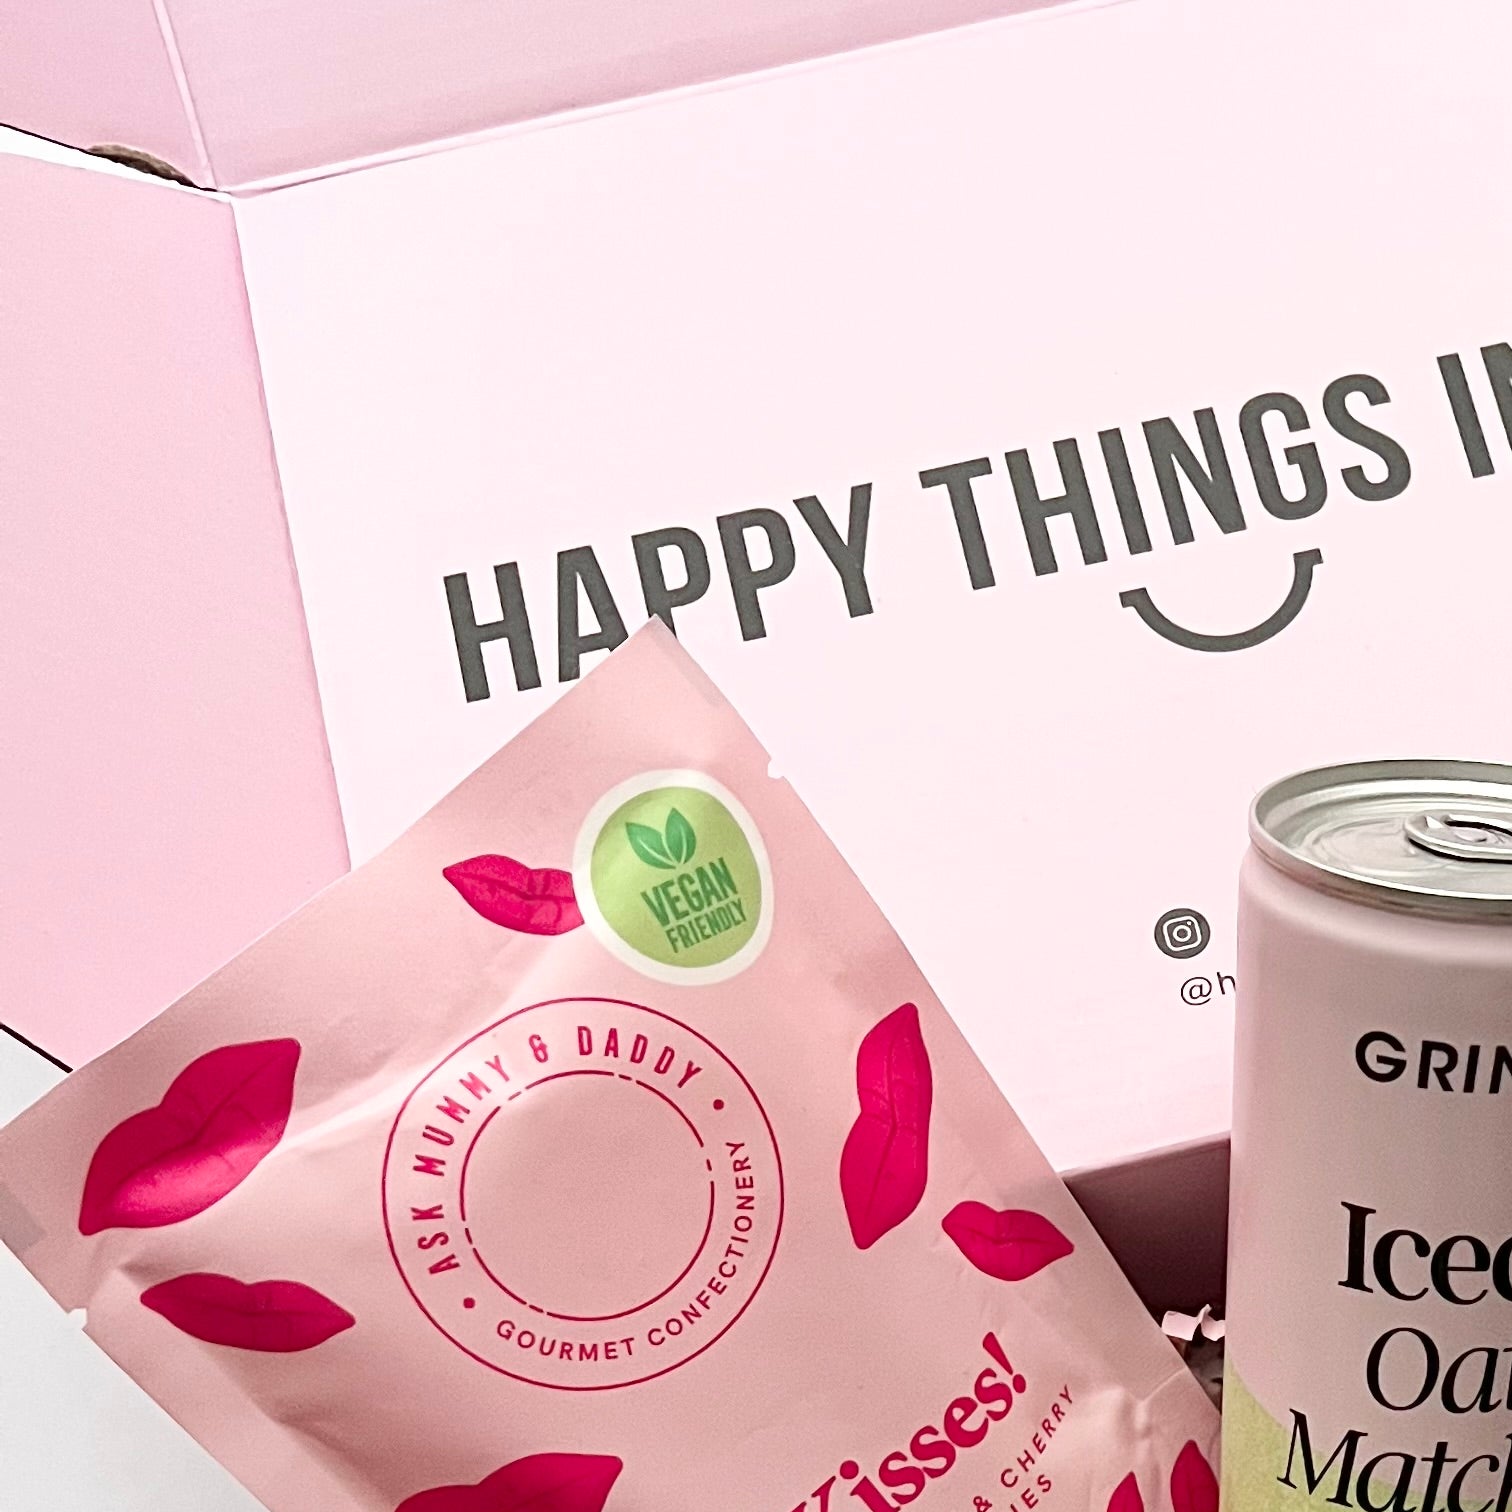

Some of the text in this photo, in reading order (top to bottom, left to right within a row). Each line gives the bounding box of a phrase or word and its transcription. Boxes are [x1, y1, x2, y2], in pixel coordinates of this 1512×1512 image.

[443, 482, 874, 703] HAPPY
[919, 373, 1411, 591] THINGS
[640, 857, 739, 927] VEGAN
[665, 898, 747, 953] FRIENDLY
[410, 1025, 702, 1275] ASK MUMMY & DADDY
[496, 1141, 755, 1361] GOURMET CONFECTIONERY
[1000, 1385, 1074, 1489] CHERRY
